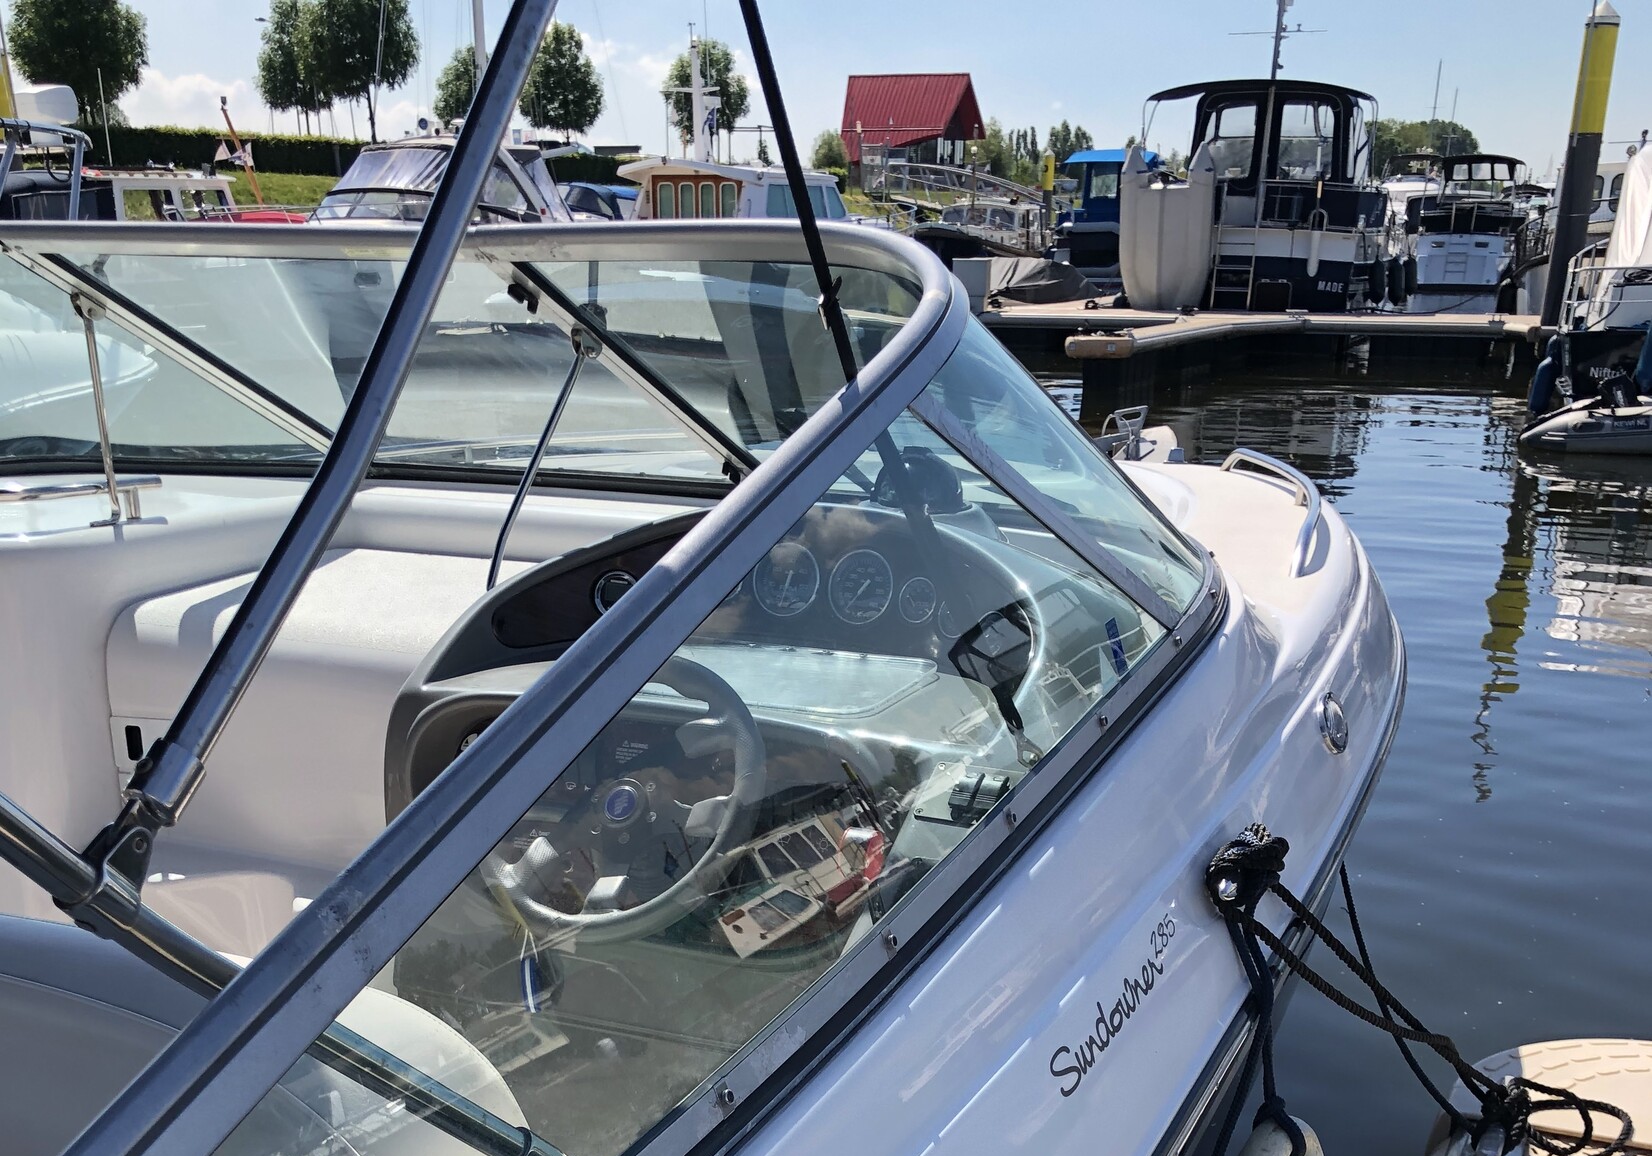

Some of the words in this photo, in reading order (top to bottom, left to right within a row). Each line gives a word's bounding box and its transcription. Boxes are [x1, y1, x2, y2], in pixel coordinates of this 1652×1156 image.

[1317, 280, 1344, 293] MADE
[1050, 958, 1164, 1097] Sundowner
[1150, 913, 1176, 959] 285
